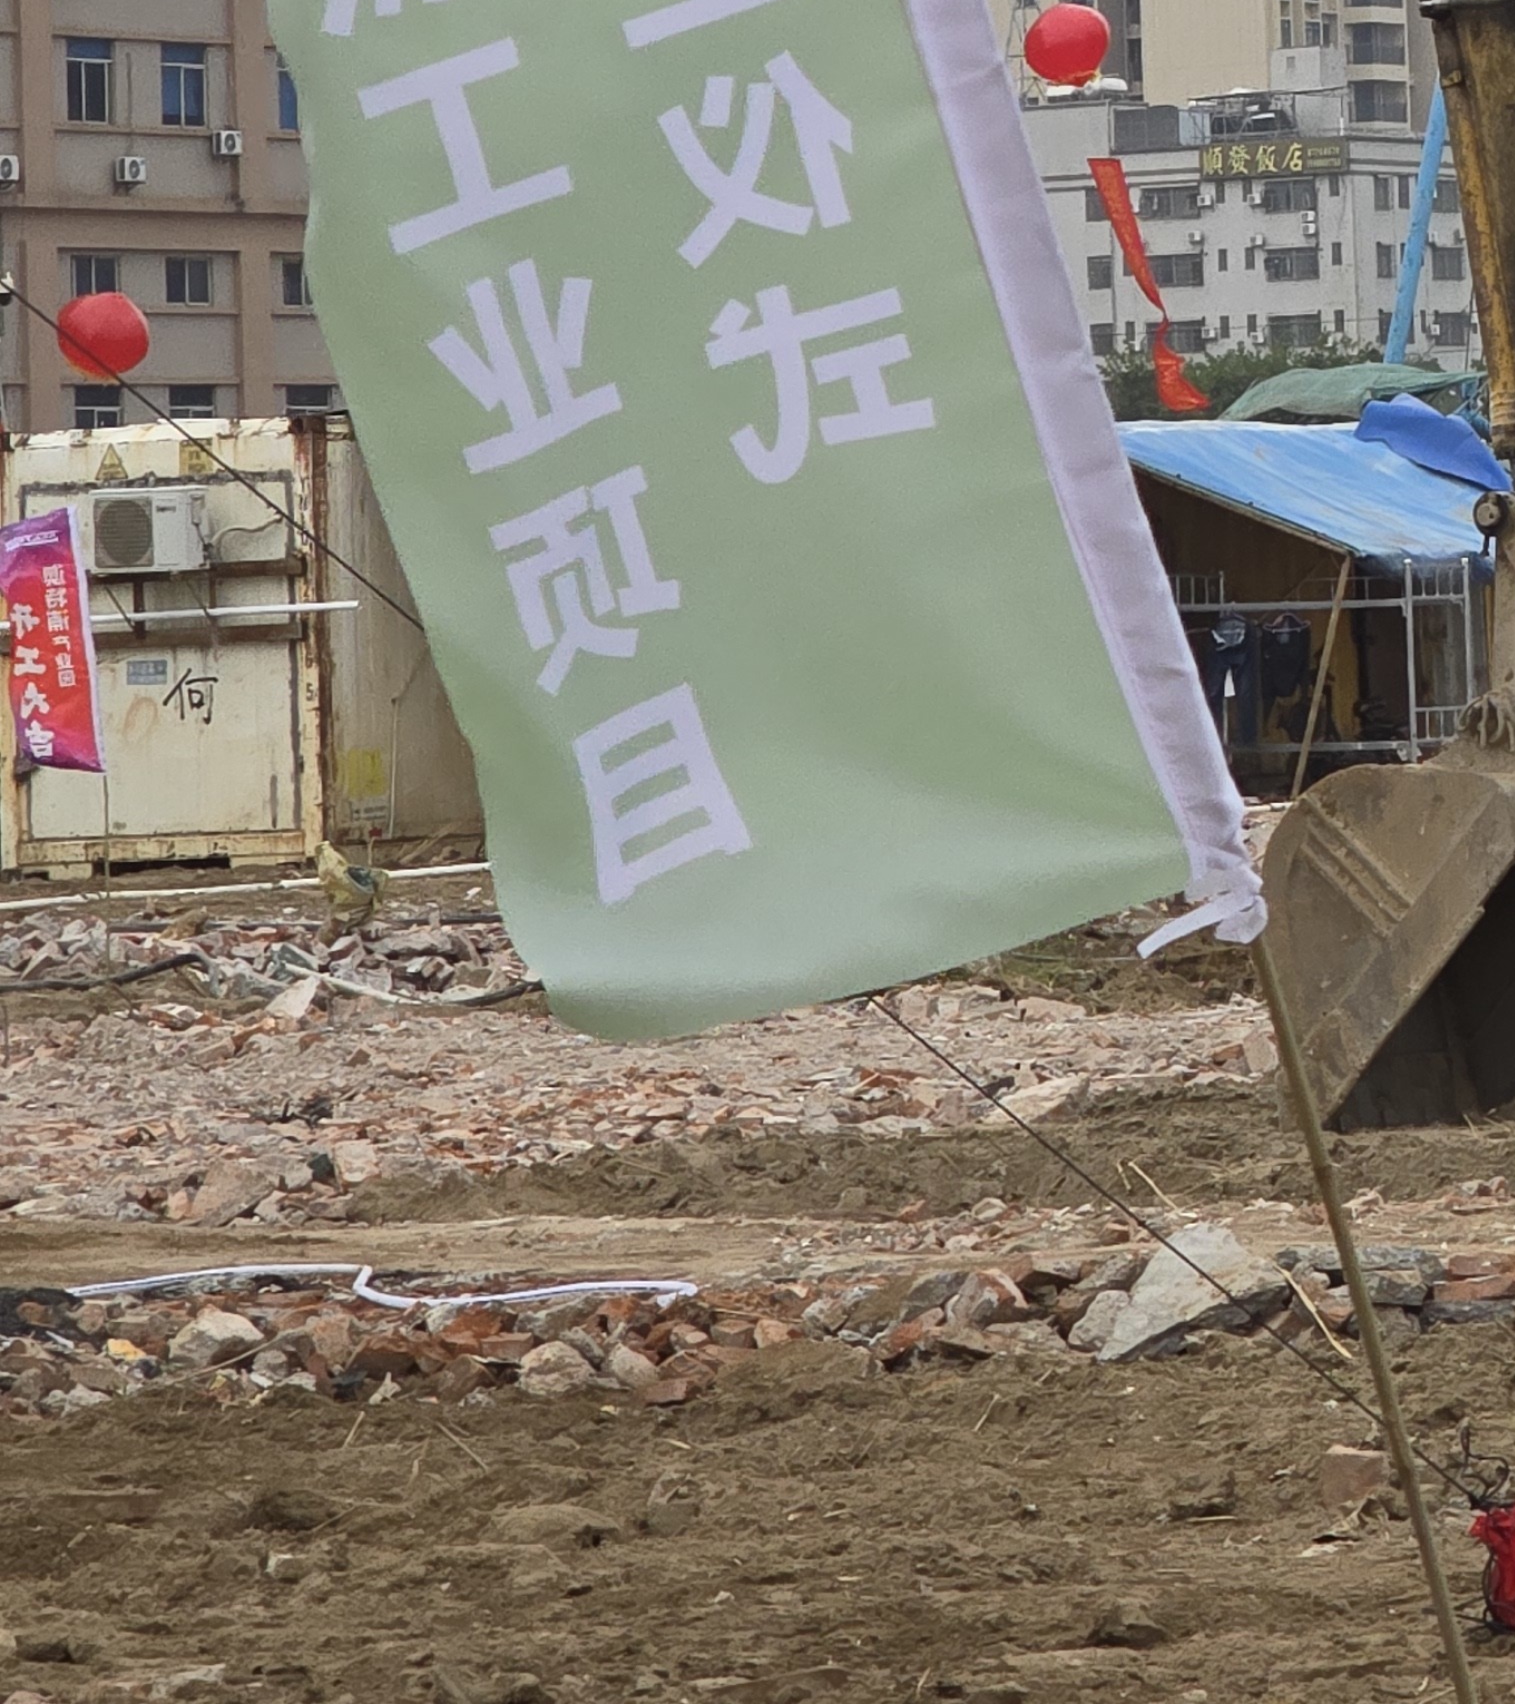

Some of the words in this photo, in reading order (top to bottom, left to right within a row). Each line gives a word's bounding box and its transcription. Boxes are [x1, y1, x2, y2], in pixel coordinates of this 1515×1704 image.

[1202, 142, 1303, 175] 順發飯店
[163, 667, 218, 724] 何
